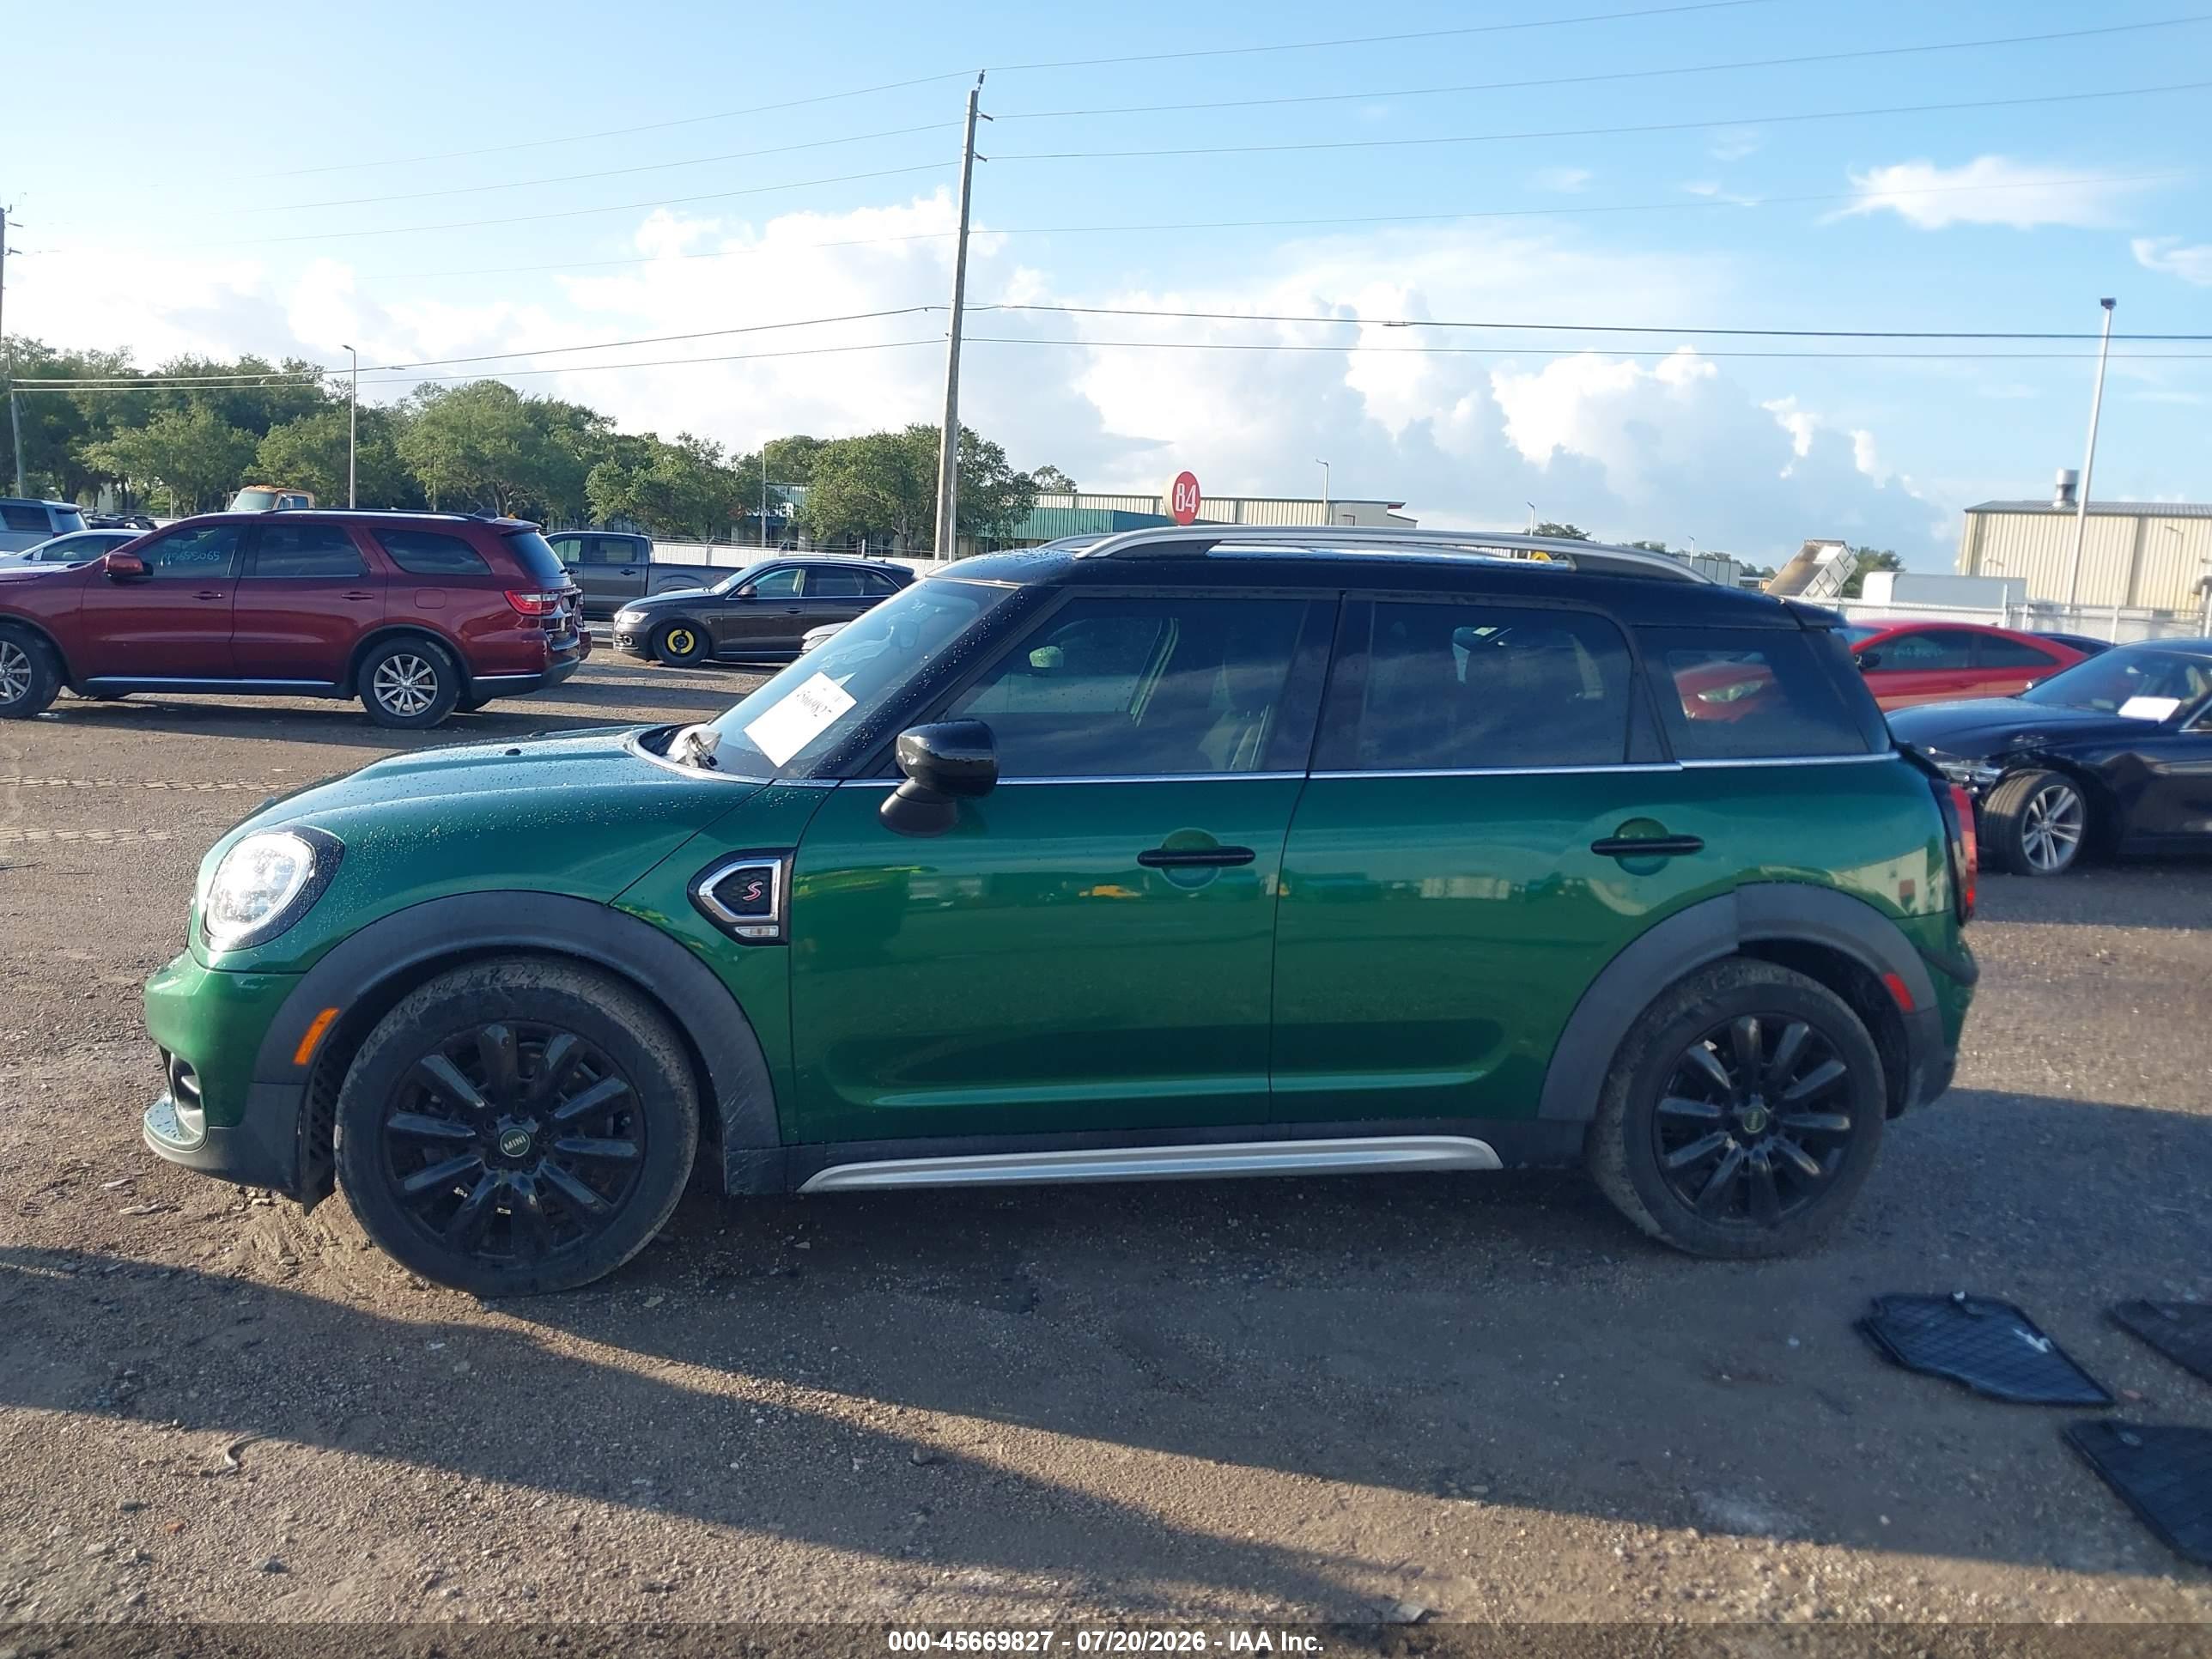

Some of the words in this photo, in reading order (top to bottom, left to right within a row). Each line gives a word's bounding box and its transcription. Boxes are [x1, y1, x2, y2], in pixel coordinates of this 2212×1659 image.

[1175, 483, 1197, 514] 84
[742, 880, 763, 902] S
[503, 1134, 527, 1152] MINI
